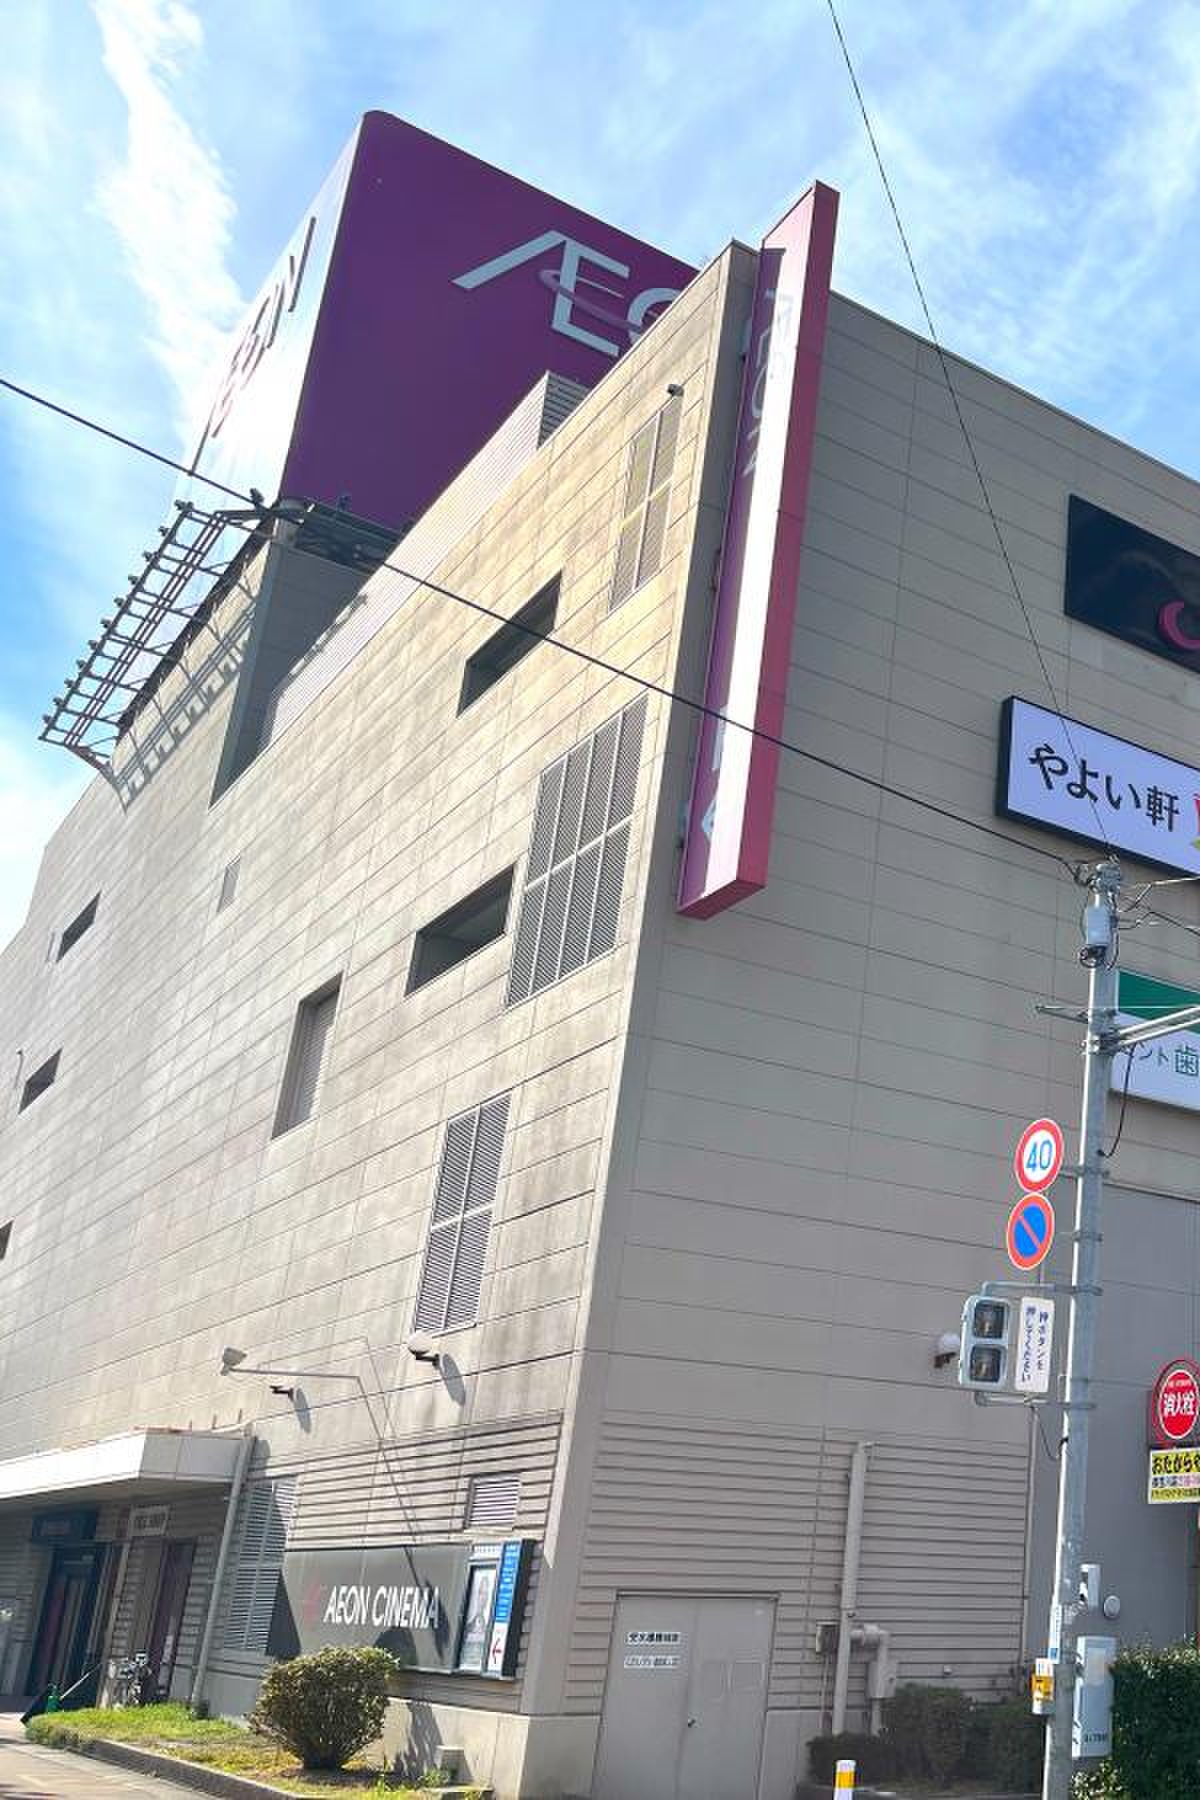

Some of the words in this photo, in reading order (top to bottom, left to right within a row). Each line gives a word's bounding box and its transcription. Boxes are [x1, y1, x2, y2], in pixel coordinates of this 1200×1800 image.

[1029, 743, 1180, 832] やよい軒
[1026, 1139, 1053, 1171] 40
[323, 1586, 370, 1626] AEON
[372, 1585, 440, 1629] CINEMA
